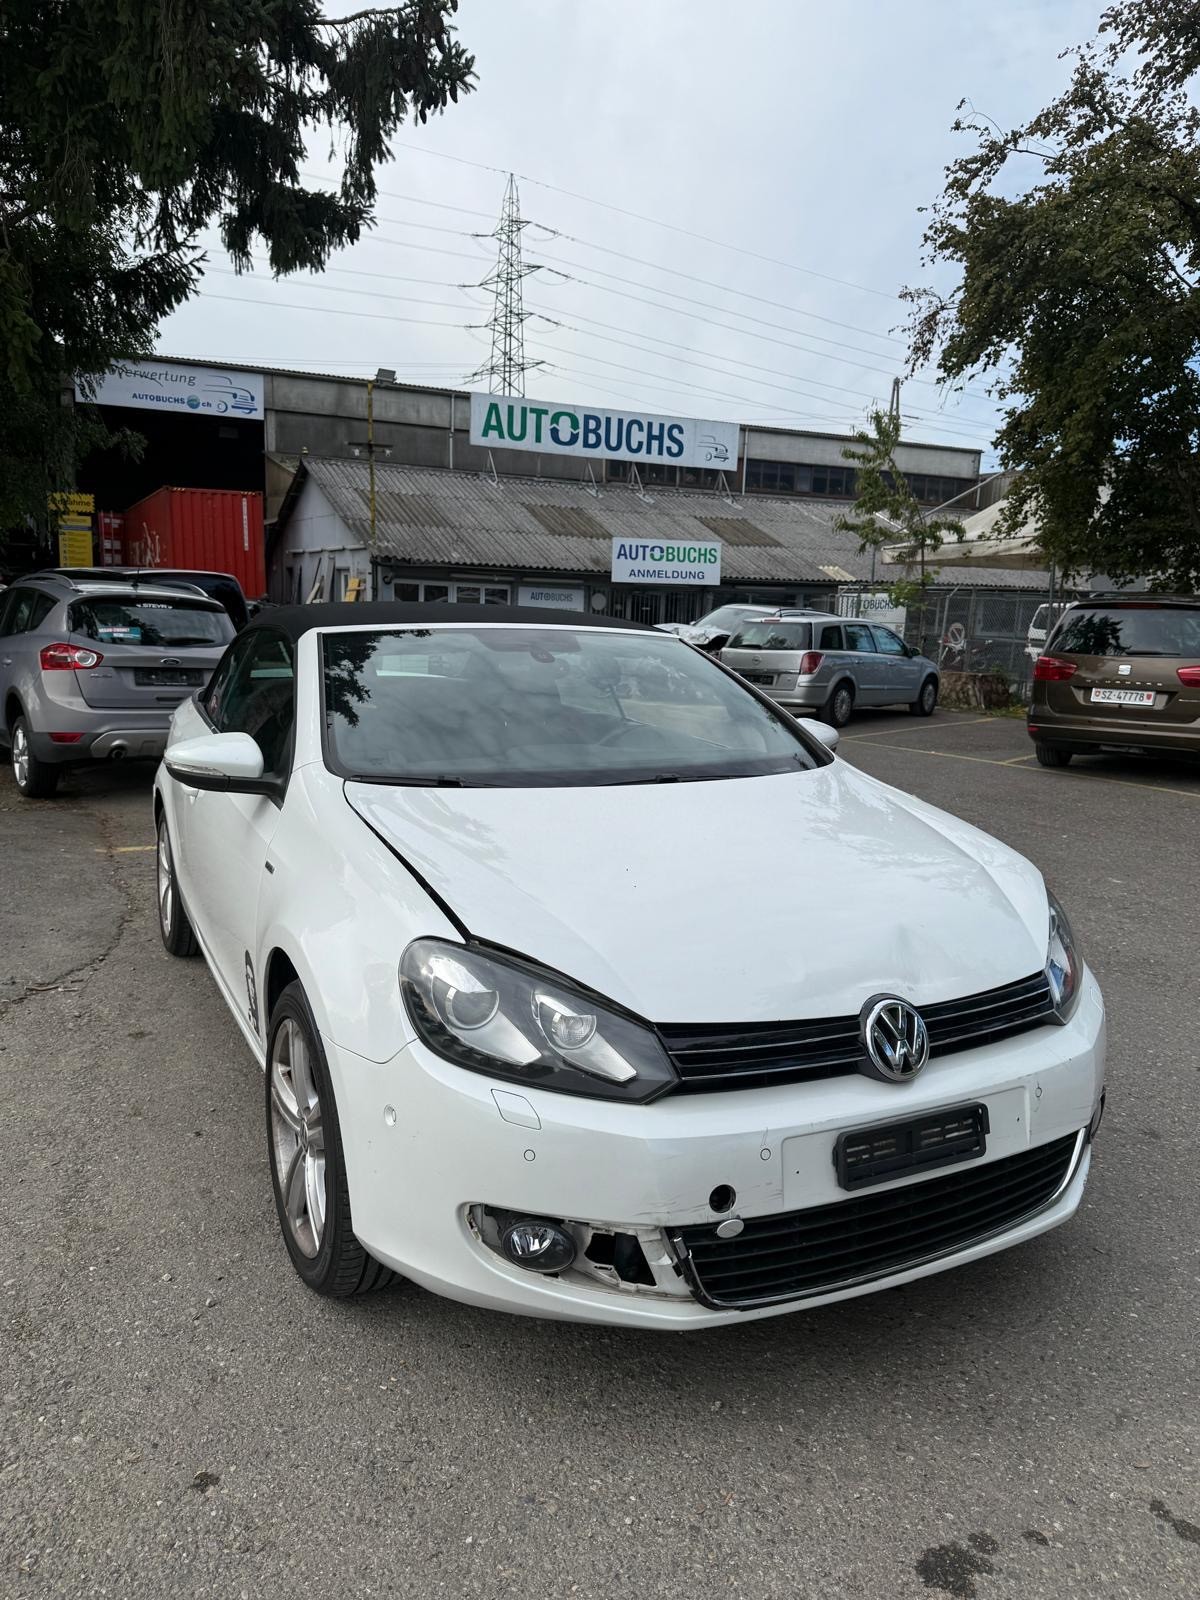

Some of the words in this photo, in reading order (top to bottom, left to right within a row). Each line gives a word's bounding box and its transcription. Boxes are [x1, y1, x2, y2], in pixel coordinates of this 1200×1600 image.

[132, 392, 186, 405] AUTOBUCHS
[482, 402, 684, 458] AUTOBUCHS
[616, 544, 717, 564] AUTOBUCHS
[628, 569, 705, 580] ANMELDUNG
[530, 591, 574, 602] AUTOBUCHS
